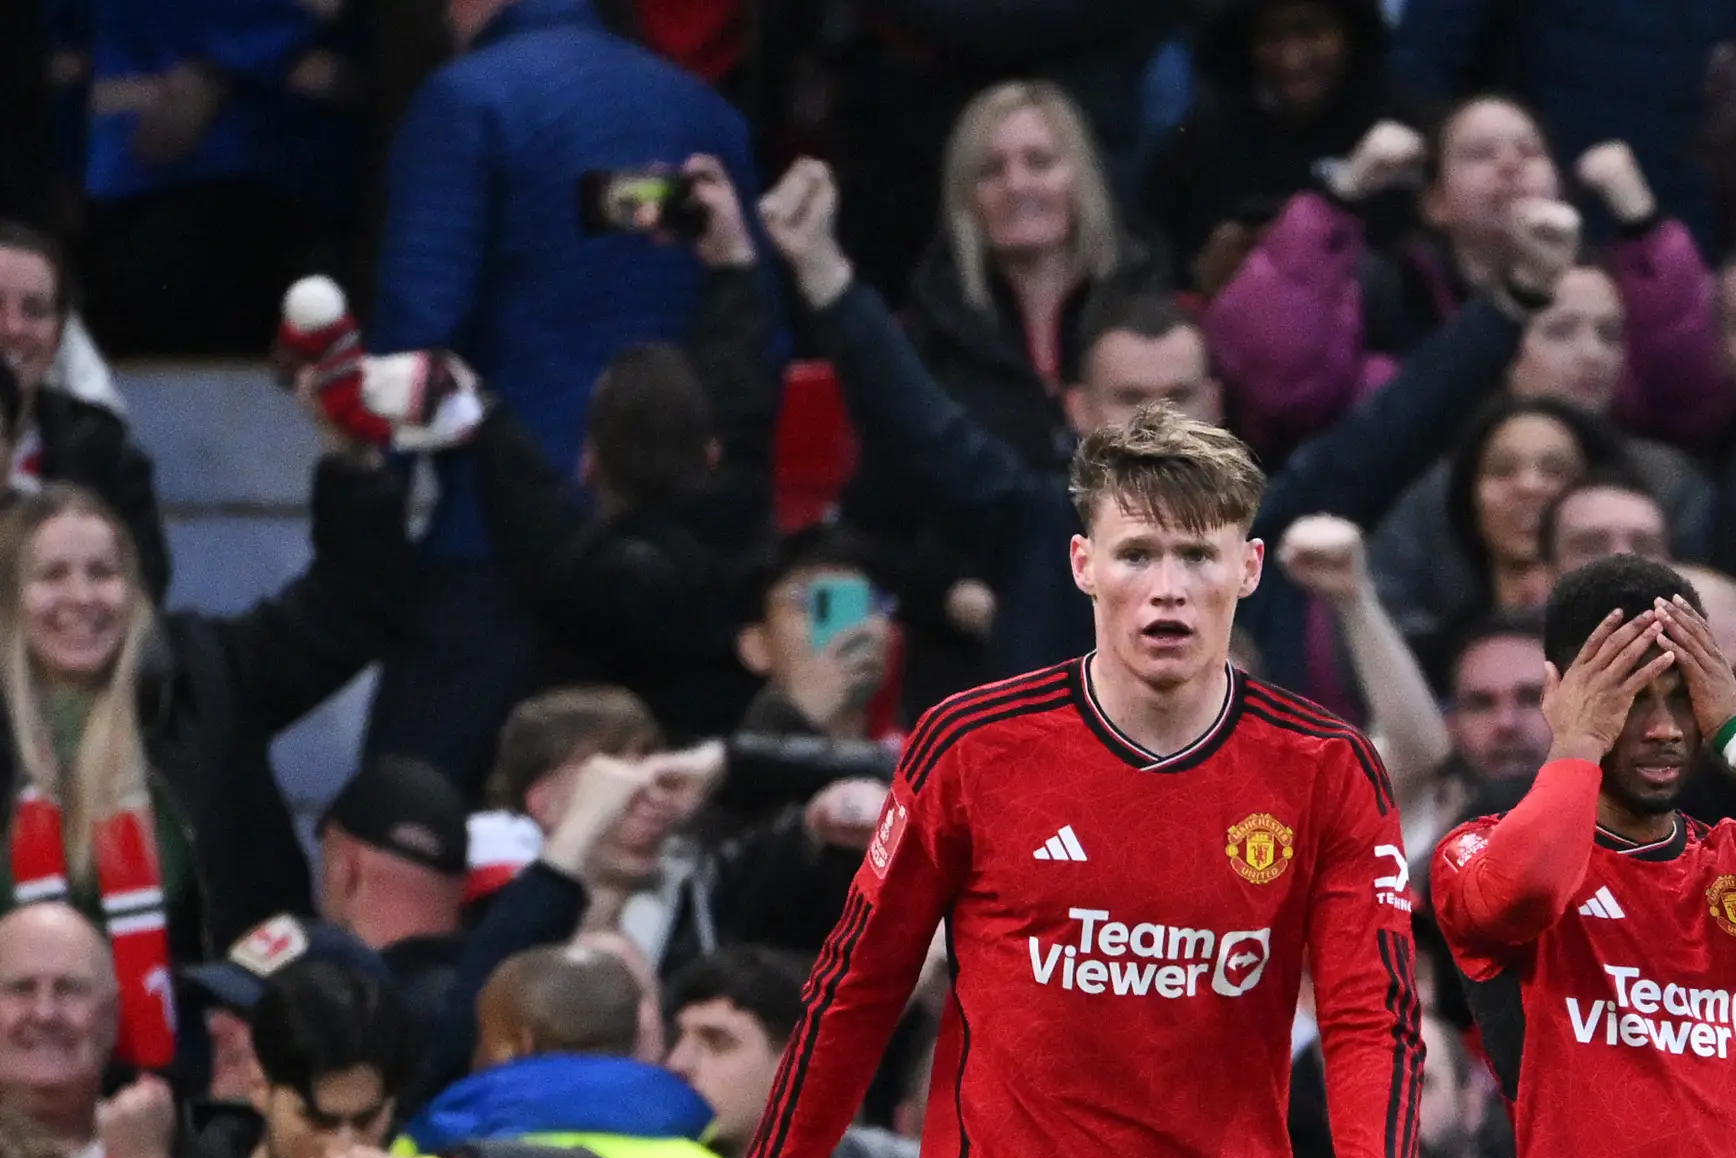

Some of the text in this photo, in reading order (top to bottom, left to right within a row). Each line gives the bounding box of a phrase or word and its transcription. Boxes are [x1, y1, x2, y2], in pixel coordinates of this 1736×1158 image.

[1232, 819, 1290, 841] MANCHESTER
[1241, 867, 1278, 881] UNITED
[1068, 907, 1216, 961] Team
[1029, 936, 1209, 999] Viewer
[1603, 963, 1729, 1024] Team
[1565, 997, 1733, 1059] Viewer
